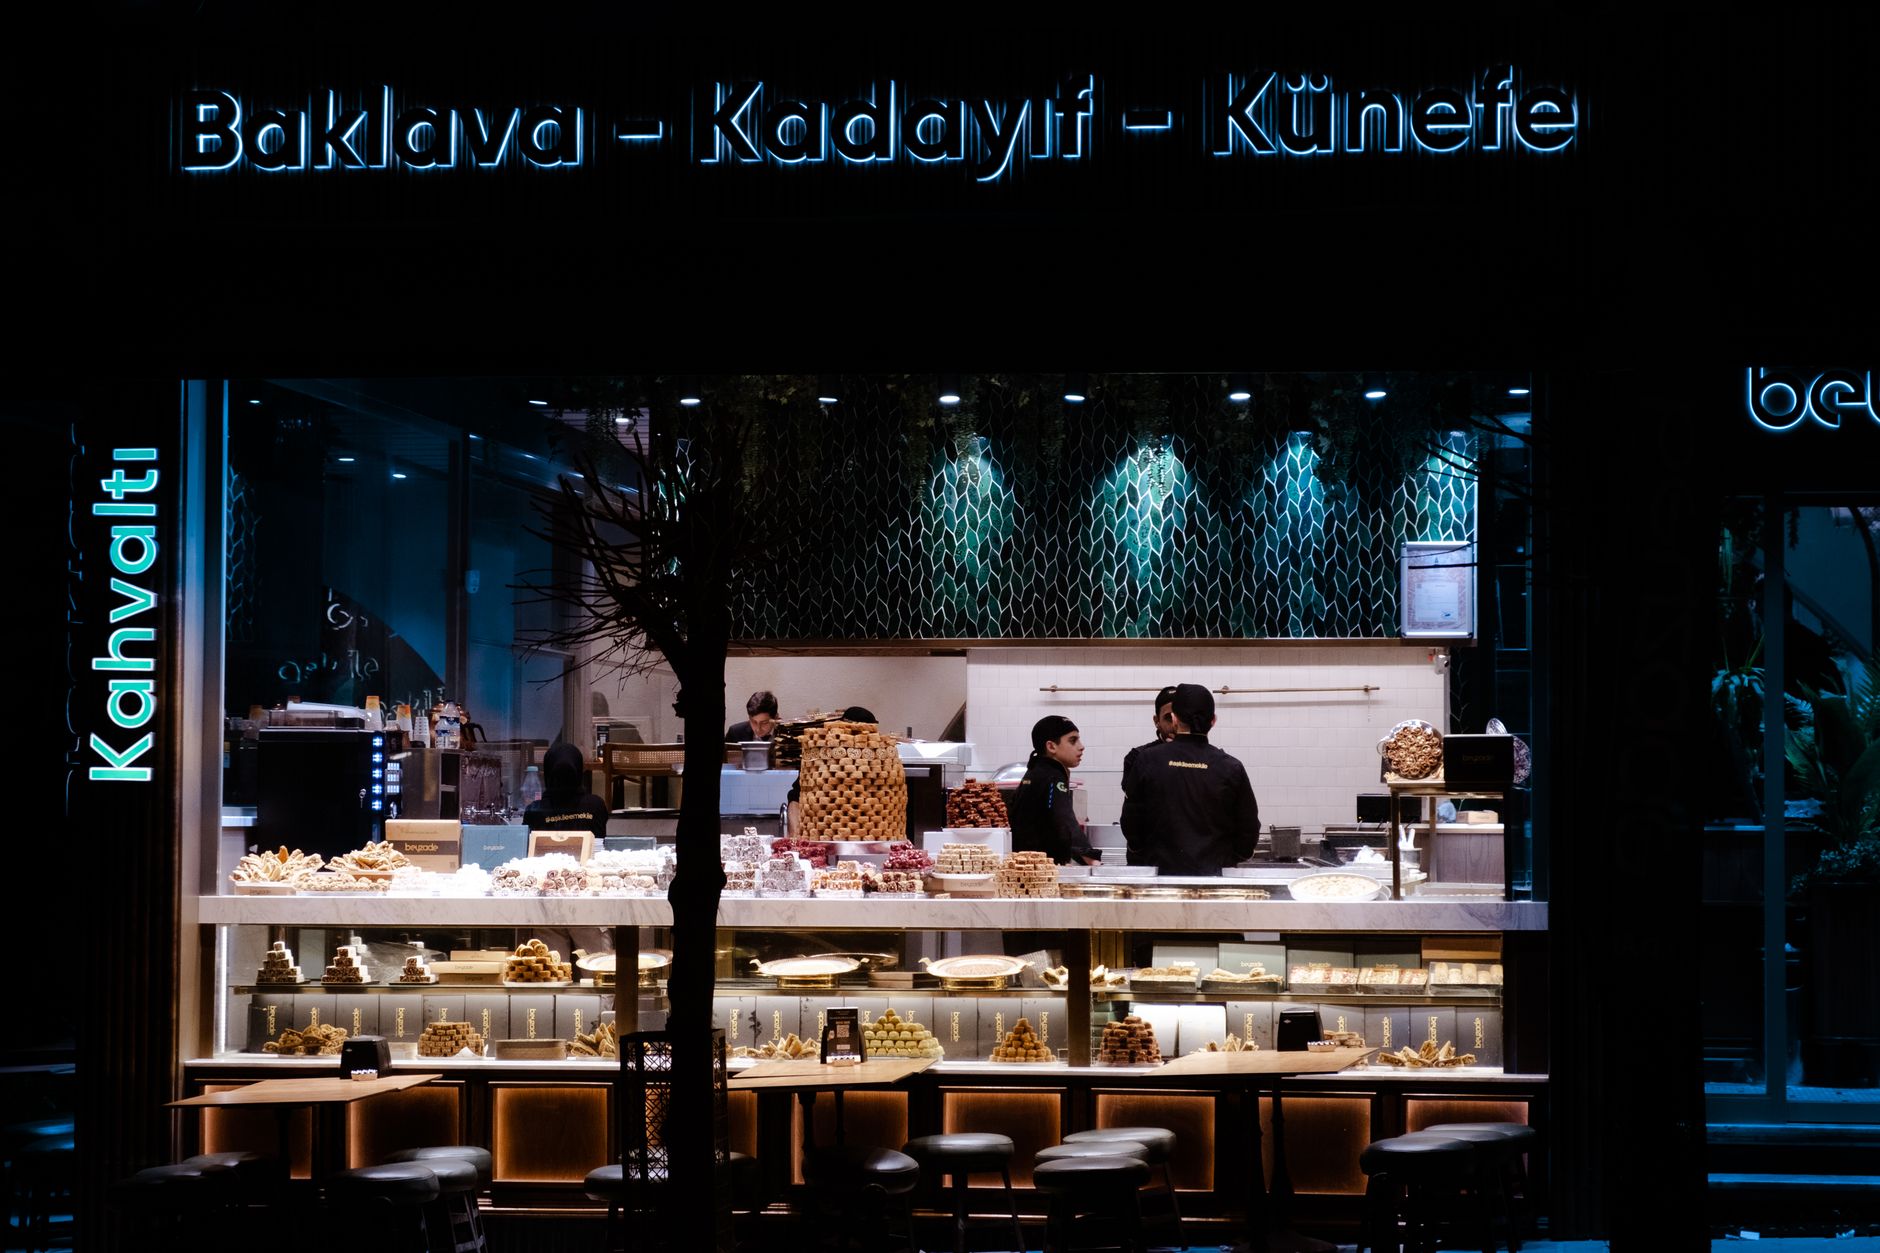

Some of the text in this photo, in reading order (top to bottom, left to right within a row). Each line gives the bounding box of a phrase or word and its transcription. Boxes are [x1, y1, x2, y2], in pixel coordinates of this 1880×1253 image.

[181, 84, 584, 171] Baklava
[700, 74, 1094, 181] Kadayıf
[1213, 65, 1577, 155] Künefe
[1747, 367, 1880, 430] be
[89, 448, 158, 781] Kahvaltı
[404, 842, 438, 852] beyzade
[268, 1005, 277, 1036] beyzade
[397, 1007, 406, 1038] beyzade
[481, 1008, 489, 1038] beyzade
[528, 1008, 537, 1038] beyzade
[731, 1009, 740, 1039] beyzade
[772, 1010, 780, 1040] beyzade
[951, 1011, 960, 1042] beyzade
[994, 1012, 1003, 1042] beyzade
[1246, 1013, 1254, 1041] beyzad
[1382, 1016, 1390, 1047] beyzade
[1473, 1017, 1482, 1048] beyzade
